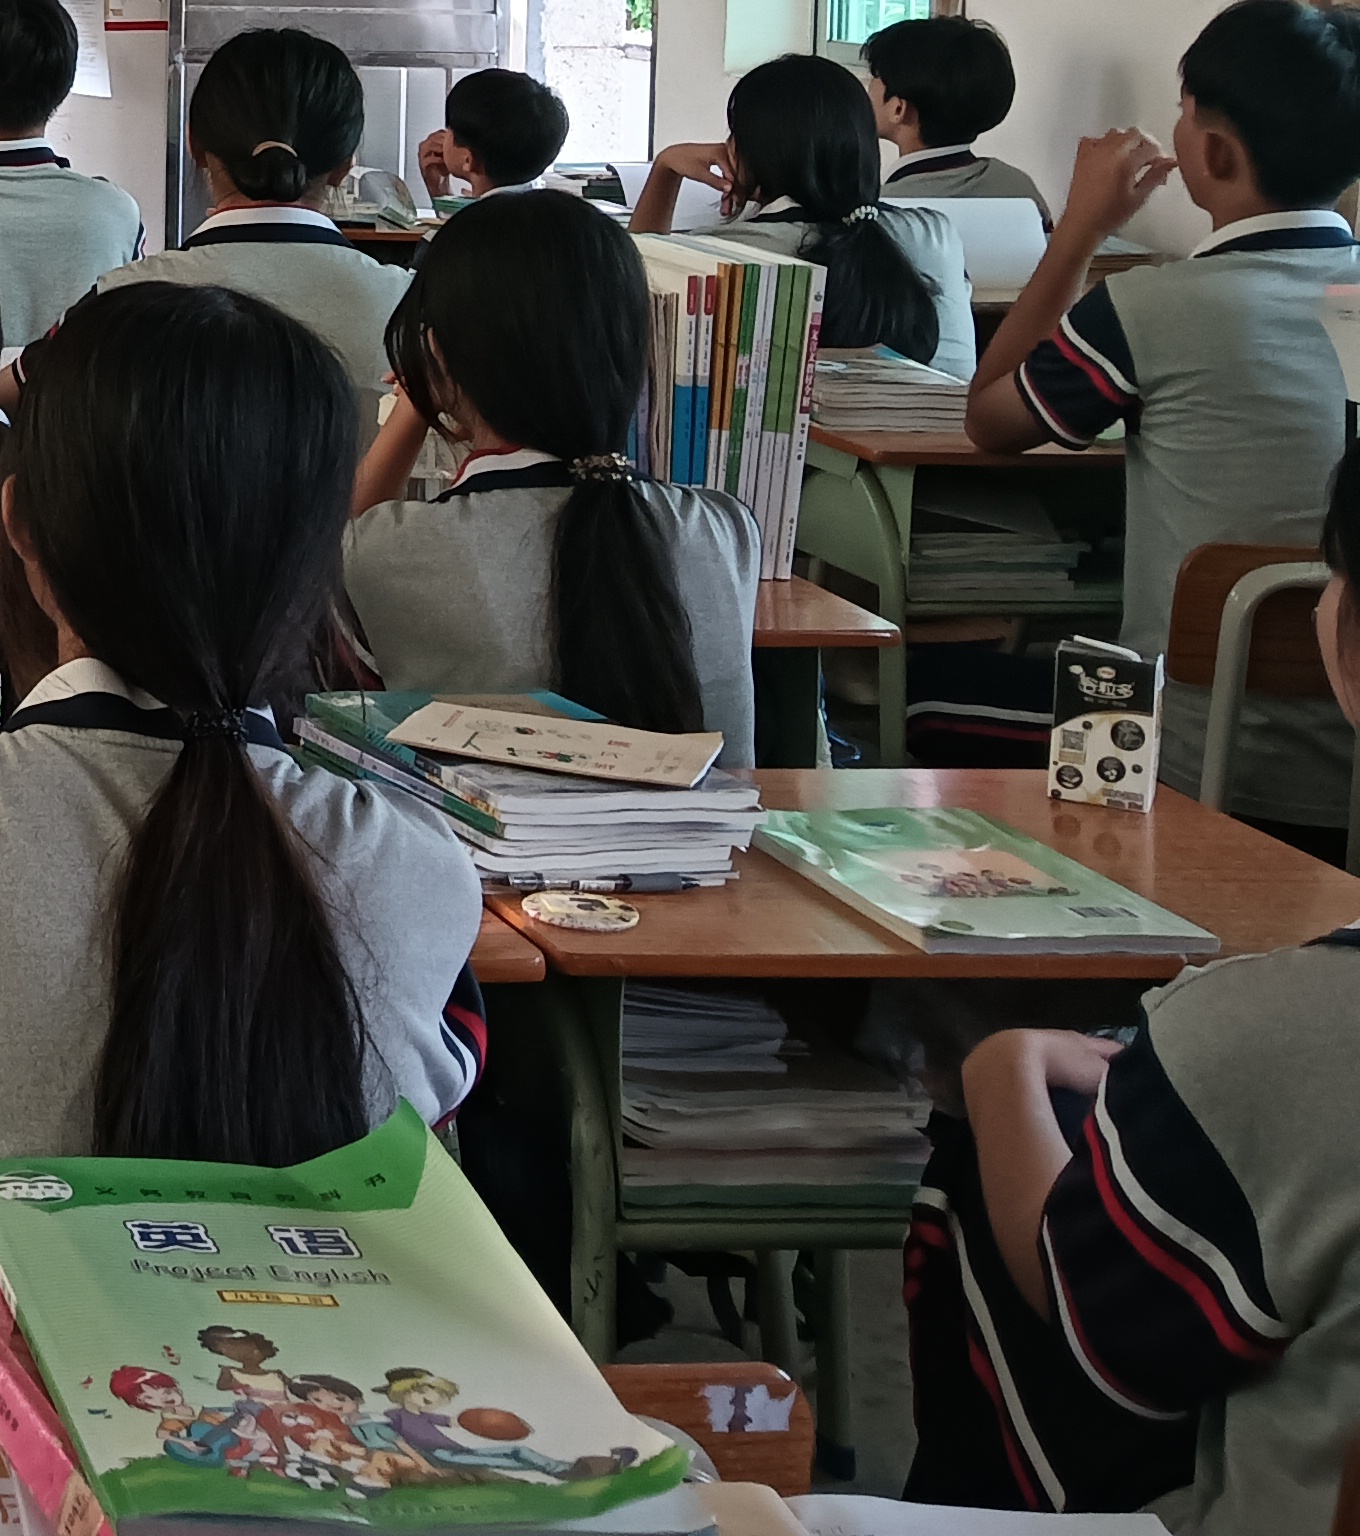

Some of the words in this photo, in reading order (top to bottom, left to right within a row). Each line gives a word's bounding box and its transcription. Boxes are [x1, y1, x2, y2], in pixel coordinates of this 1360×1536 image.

[123, 1219, 363, 1261] 英语
[130, 1258, 258, 1283] Project
[267, 1263, 391, 1289] English
